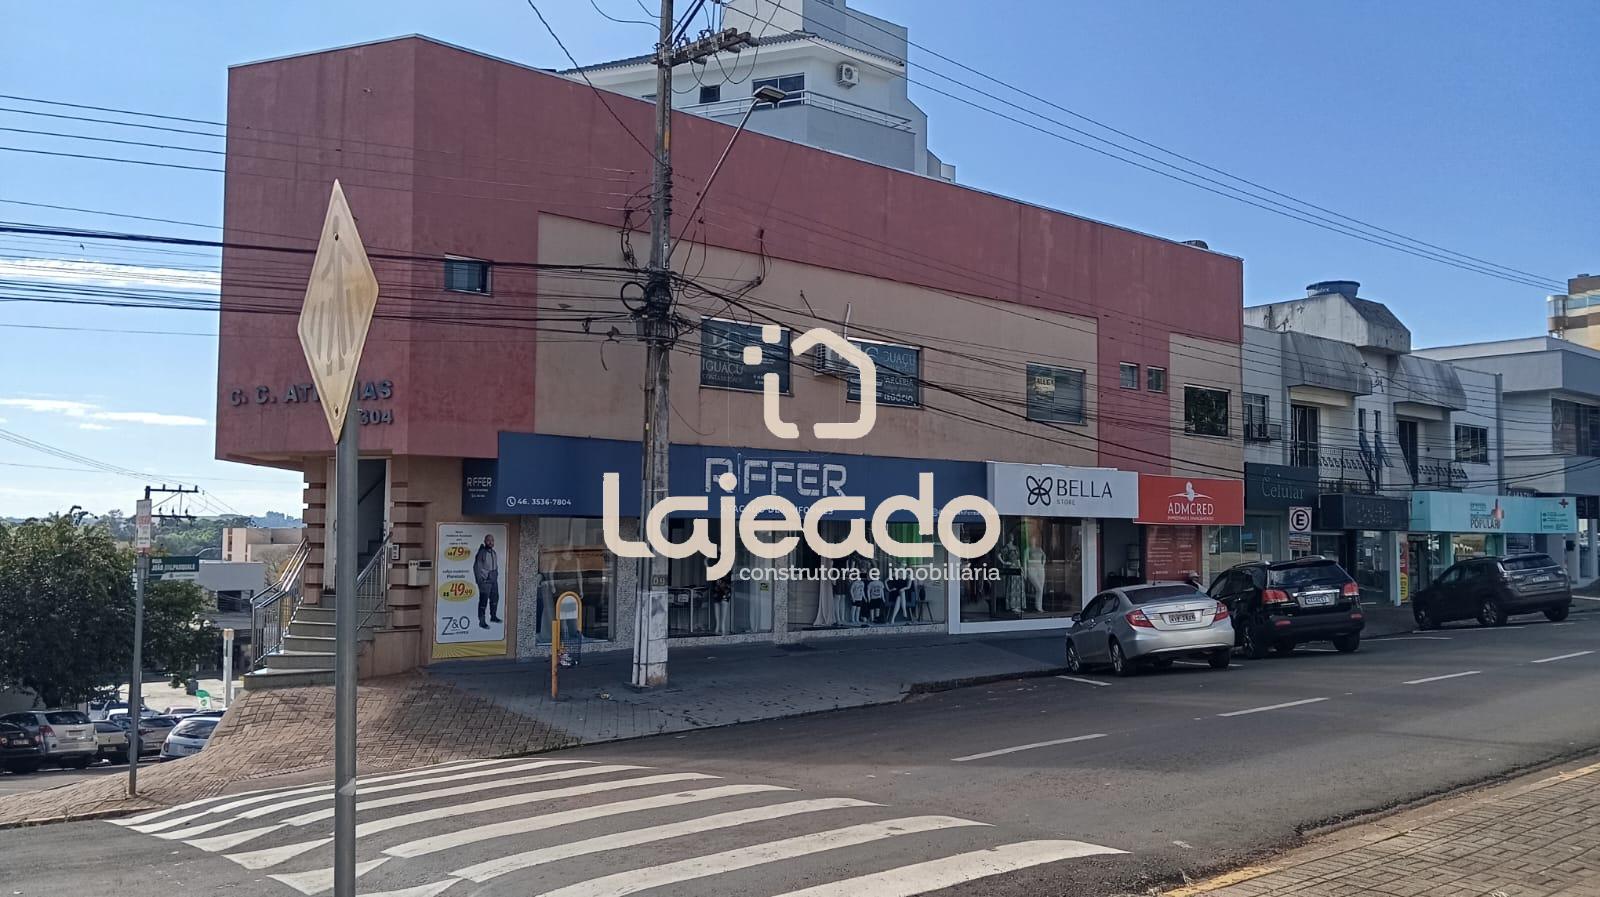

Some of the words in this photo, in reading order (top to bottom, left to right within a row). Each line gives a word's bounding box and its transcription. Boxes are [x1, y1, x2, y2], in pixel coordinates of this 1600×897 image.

[1057, 478, 1113, 498] BELLA
[1262, 481, 1305, 499] Celular
[517, 498, 530, 506] 46.
[531, 498, 572, 506] 3536-7804
[1056, 498, 1076, 506] STORE
[1167, 502, 1214, 515] ADMCRED
[1296, 513, 1305, 526] E
[441, 615, 470, 636] Z&O
